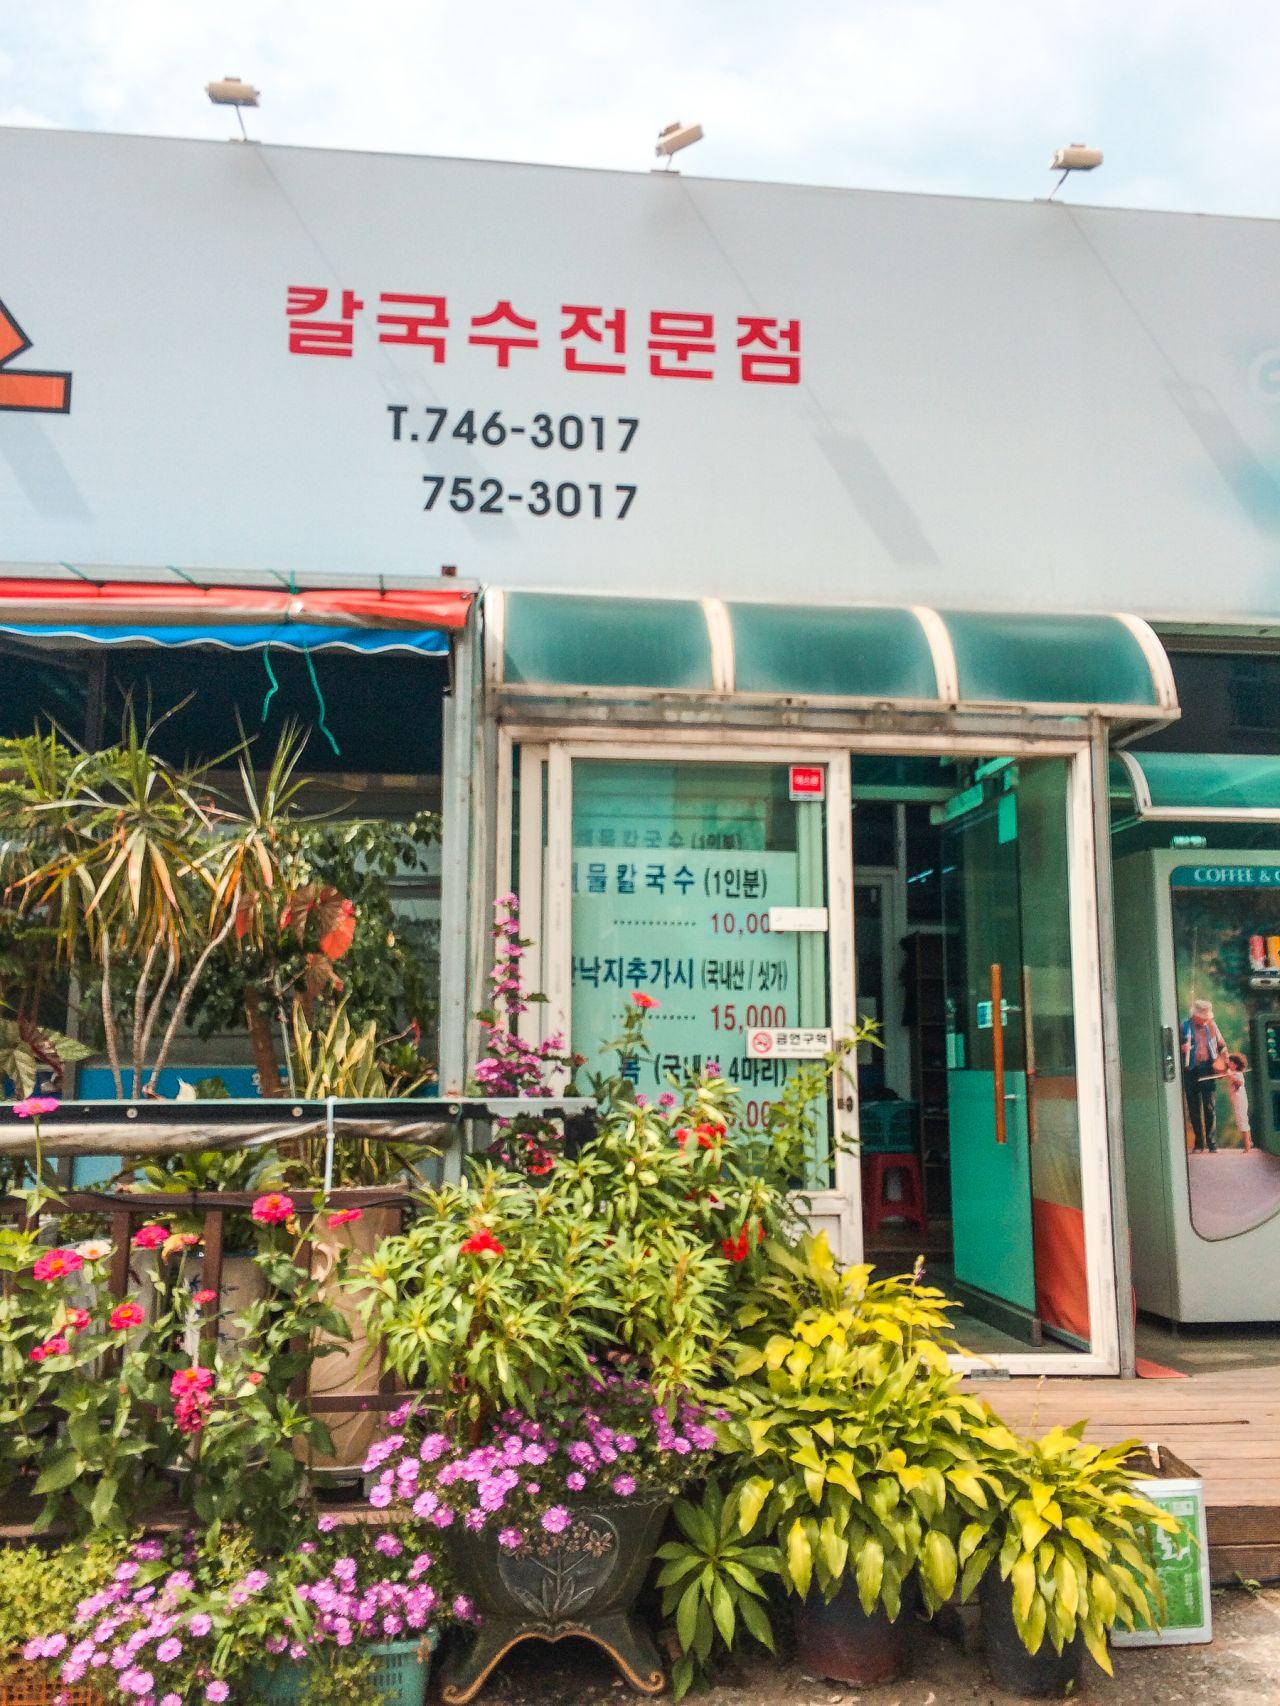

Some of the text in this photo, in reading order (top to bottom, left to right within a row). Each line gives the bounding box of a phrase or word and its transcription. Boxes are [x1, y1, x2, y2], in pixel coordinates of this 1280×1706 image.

[286, 285, 801, 385] 칼국수전문점
[387, 405, 640, 452] T.746-3017
[422, 475, 638, 519] 752-3017
[573, 863, 768, 899] 물칼국수 (1인분)
[1194, 868, 1255, 882] COFFEE
[711, 912, 785, 937] 10,00
[711, 1004, 786, 1034] 15,000
[776, 1031, 828, 1046] 금연구역
